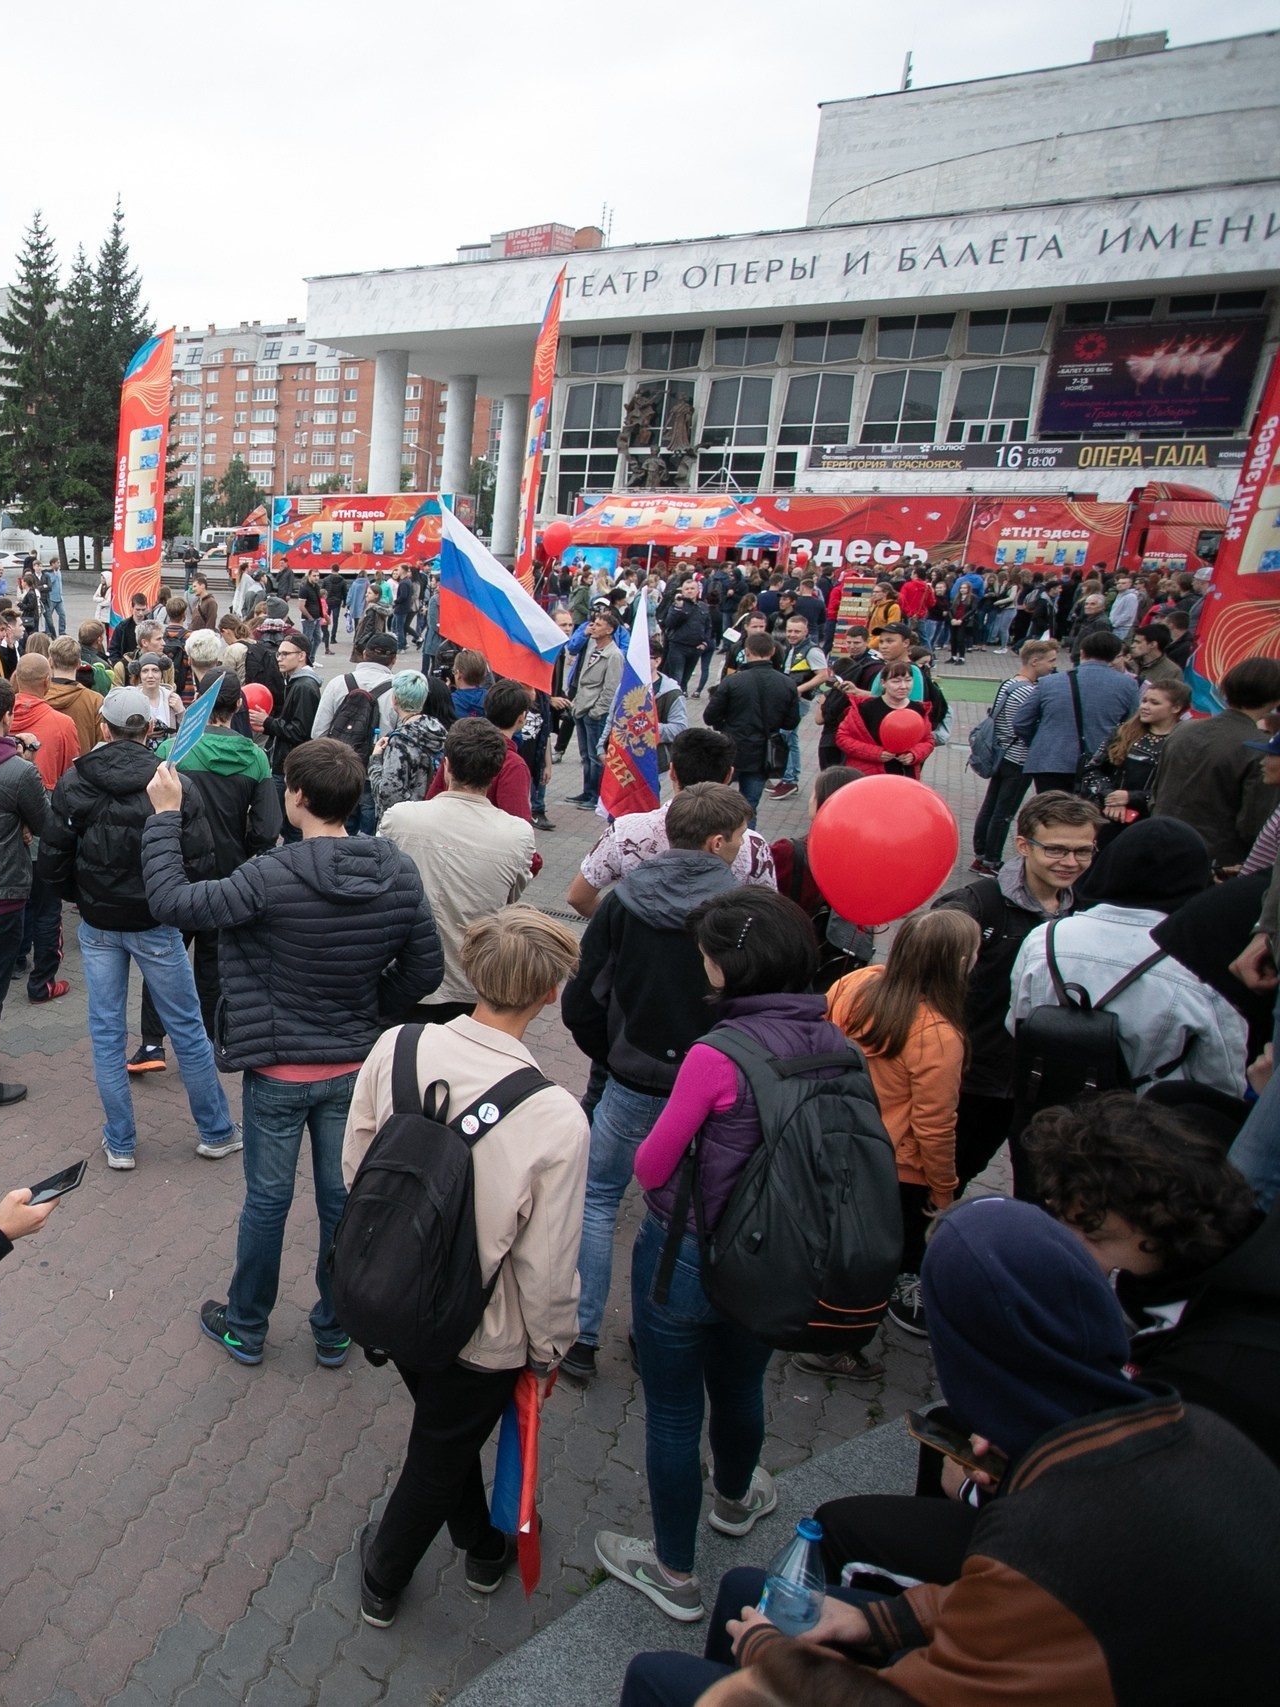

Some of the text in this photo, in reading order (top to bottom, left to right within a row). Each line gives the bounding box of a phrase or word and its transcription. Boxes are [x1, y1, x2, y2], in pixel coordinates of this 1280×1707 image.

[564, 270, 659, 298] ТЕАТР
[683, 256, 817, 289] ОПЕРЫ
[843, 251, 871, 276] И
[897, 234, 1064, 272] БАЛЕТА
[892, 460, 963, 469] КРАСНОЯРСК
[995, 445, 1064, 468] 16 СЕНТЯБРЯ
[1026, 456, 1057, 467] 18:00
[1224, 415, 1280, 541] #ТНТздесь
[114, 455, 127, 531] #ТНТздесь
[331, 509, 385, 519] #ТНТздесь
[598, 506, 721, 530] ТНТ
[311, 520, 407, 555] ТНТ
[1000, 527, 1090, 539] #ТНТздесь
[994, 539, 1089, 566] ТНТ
[481, 1105, 496, 1121] F
